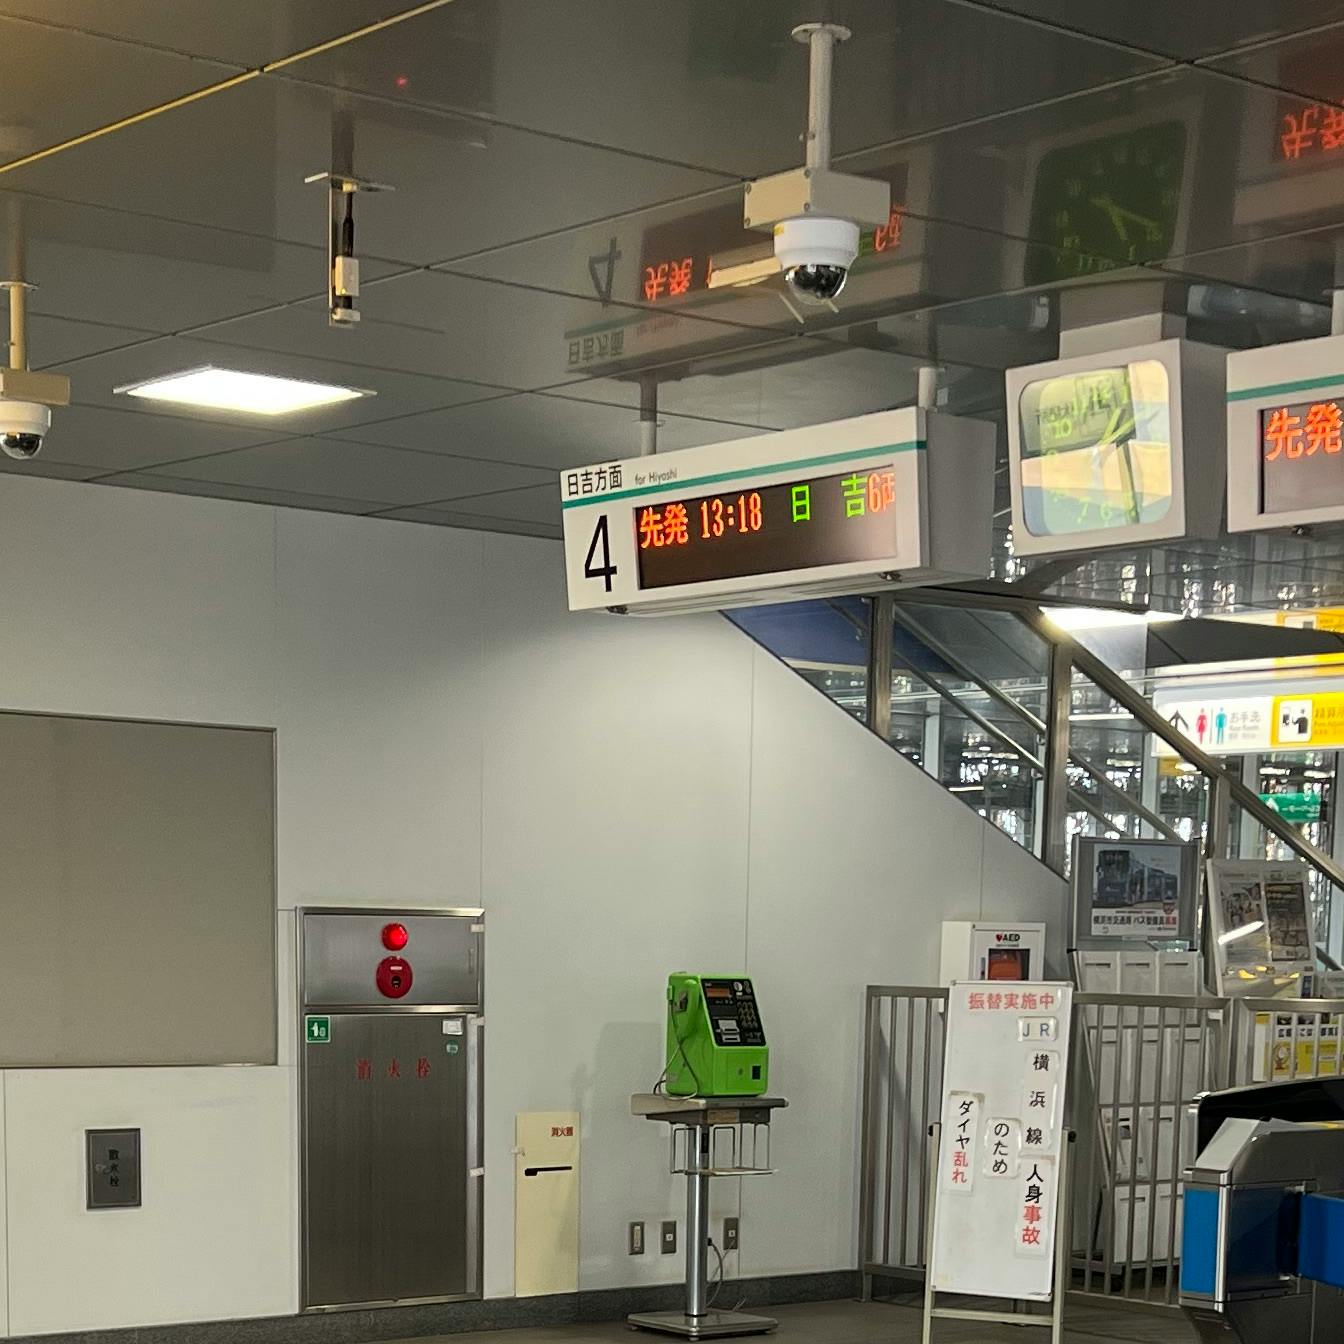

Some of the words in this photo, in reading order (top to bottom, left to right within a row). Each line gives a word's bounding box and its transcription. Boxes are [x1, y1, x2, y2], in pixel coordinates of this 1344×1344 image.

[1264, 401, 1344, 463] 先発
[566, 465, 623, 497] 日吉方面
[648, 467, 678, 485] Hiyoshi
[639, 503, 689, 549] 先発
[700, 491, 762, 540] 13:18
[584, 515, 618, 593] 4
[1003, 933, 1021, 942] AED
[968, 992, 1055, 1011] 振替実施中
[357, 1056, 431, 1081] 消火栓
[1025, 1053, 1050, 1145] 横浜線
[951, 1099, 975, 1184] ダイヤ乱れ
[992, 1122, 1010, 1175] のため
[1021, 1163, 1044, 1245] 人身事故
